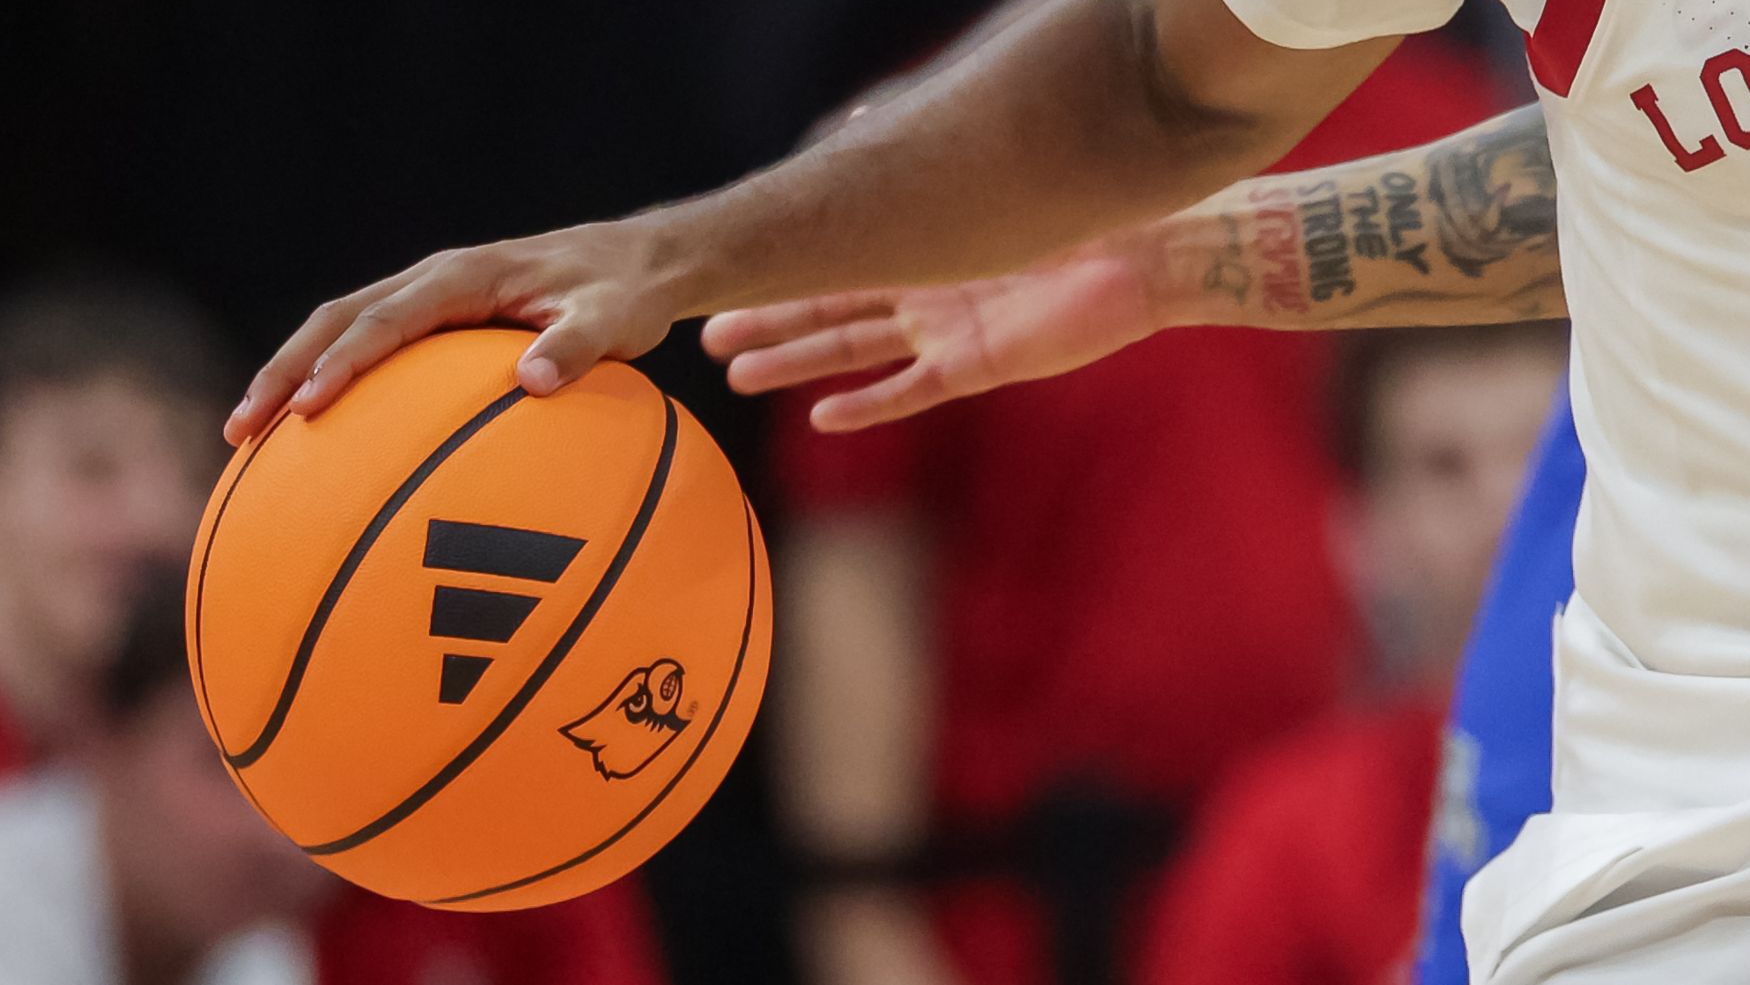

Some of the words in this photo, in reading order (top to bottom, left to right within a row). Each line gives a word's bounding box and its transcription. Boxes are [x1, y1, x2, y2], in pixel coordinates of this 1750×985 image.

[1296, 179, 1355, 303] STRONG
[1346, 185, 1389, 261] THE
[1380, 170, 1431, 275] ONLY
